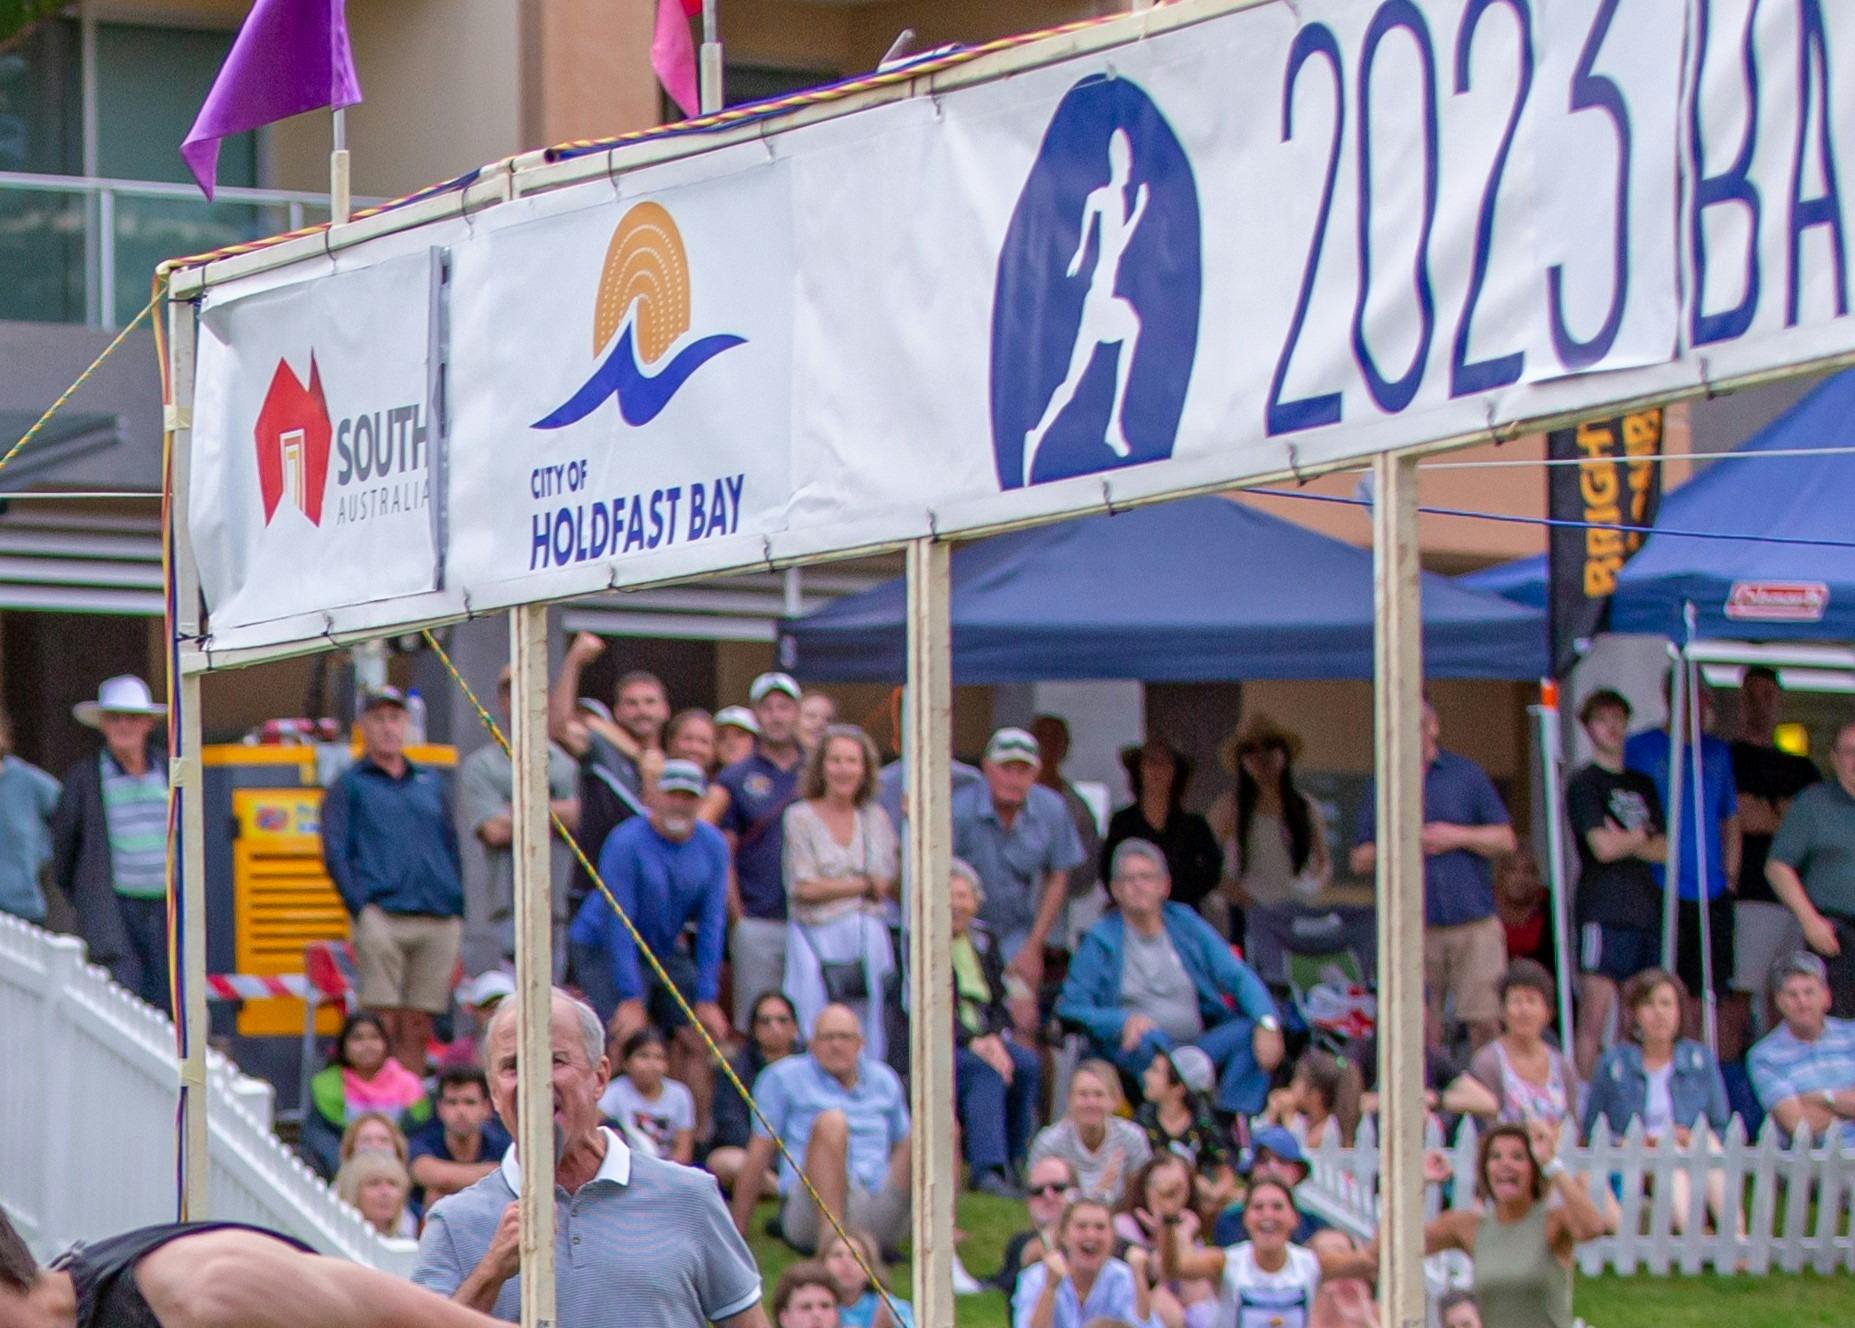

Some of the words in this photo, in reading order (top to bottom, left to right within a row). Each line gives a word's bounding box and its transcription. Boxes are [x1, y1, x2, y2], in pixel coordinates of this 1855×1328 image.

[1265, 0, 1632, 438] 2023
[1689, 0, 1850, 349] BA
[337, 403, 428, 487] SOUTH
[531, 464, 565, 500] CITY
[567, 459, 588, 493] OF
[529, 486, 682, 572] HOLDFAST
[686, 473, 746, 542] BAY
